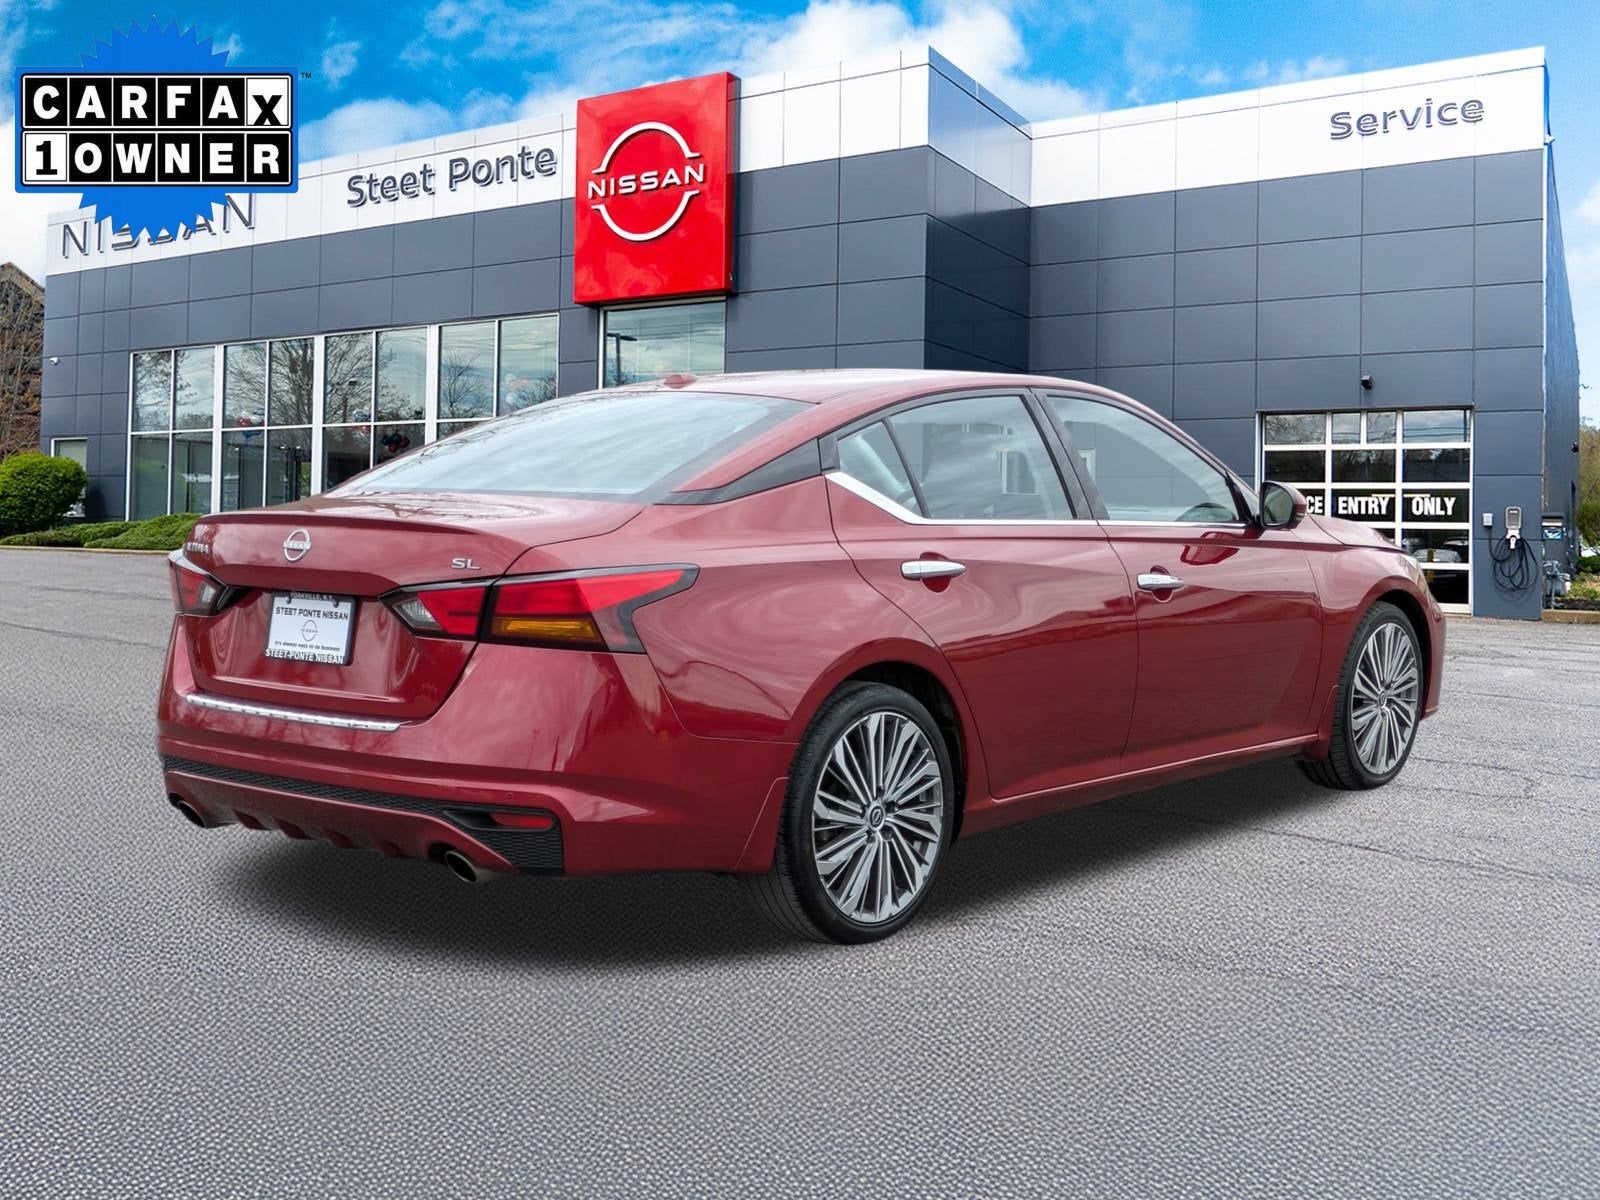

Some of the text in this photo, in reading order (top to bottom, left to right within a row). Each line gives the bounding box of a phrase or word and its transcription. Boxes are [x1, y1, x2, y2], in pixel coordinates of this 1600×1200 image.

[1330, 98, 1484, 140] Service
[346, 146, 557, 208] Steet Ponte
[588, 163, 704, 199] NISSAN
[1337, 496, 1390, 515] ENTRY
[1411, 496, 1456, 516] ONLY
[450, 556, 481, 570] SL
[275, 606, 349, 620] STEET PONTE NISSAN
[315, 652, 344, 665] NISSAN
